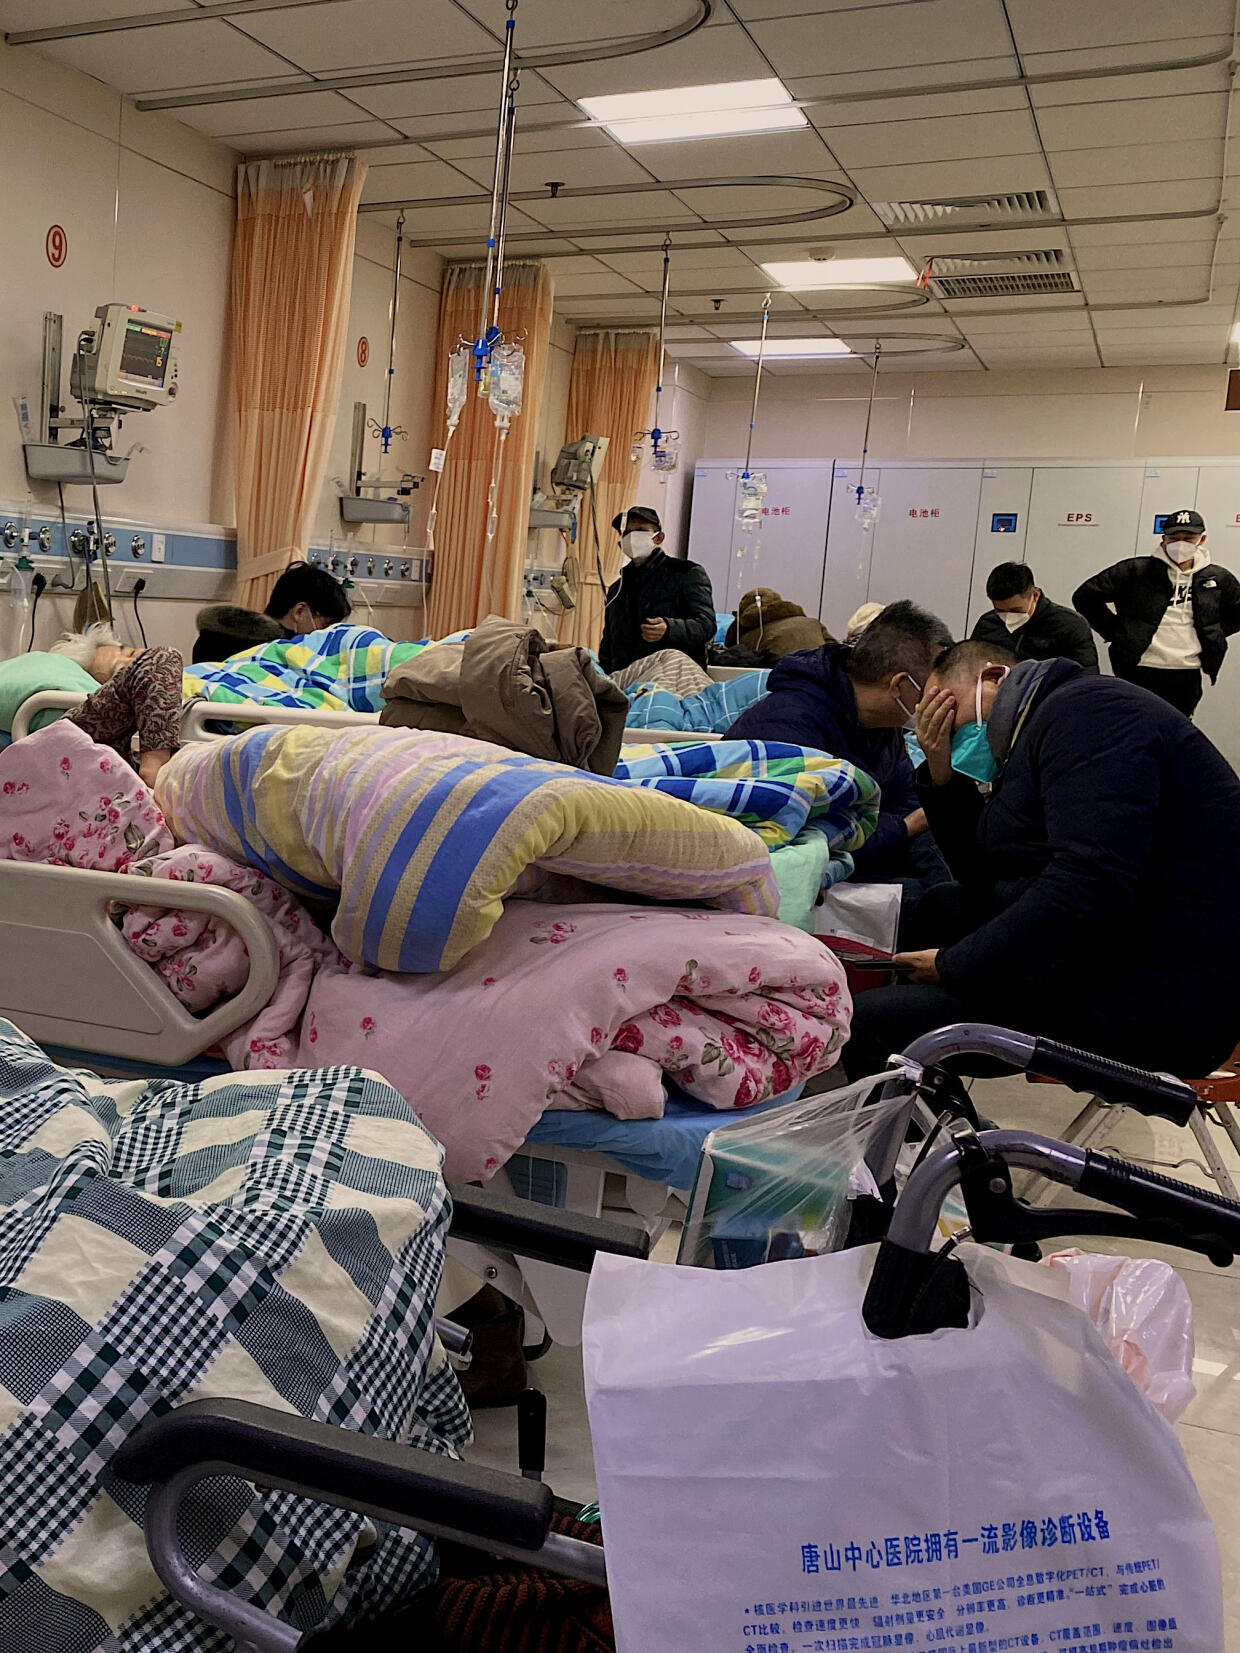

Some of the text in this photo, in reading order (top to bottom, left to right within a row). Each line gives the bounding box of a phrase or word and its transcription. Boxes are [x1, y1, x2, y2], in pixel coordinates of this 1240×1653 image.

[761, 506, 791, 516] 电池柜
[909, 508, 940, 518] 电池柜
[1067, 513, 1093, 522] EPS
[801, 1509, 1110, 1574] 唐山中心医院拥有一流影像诊断设备
